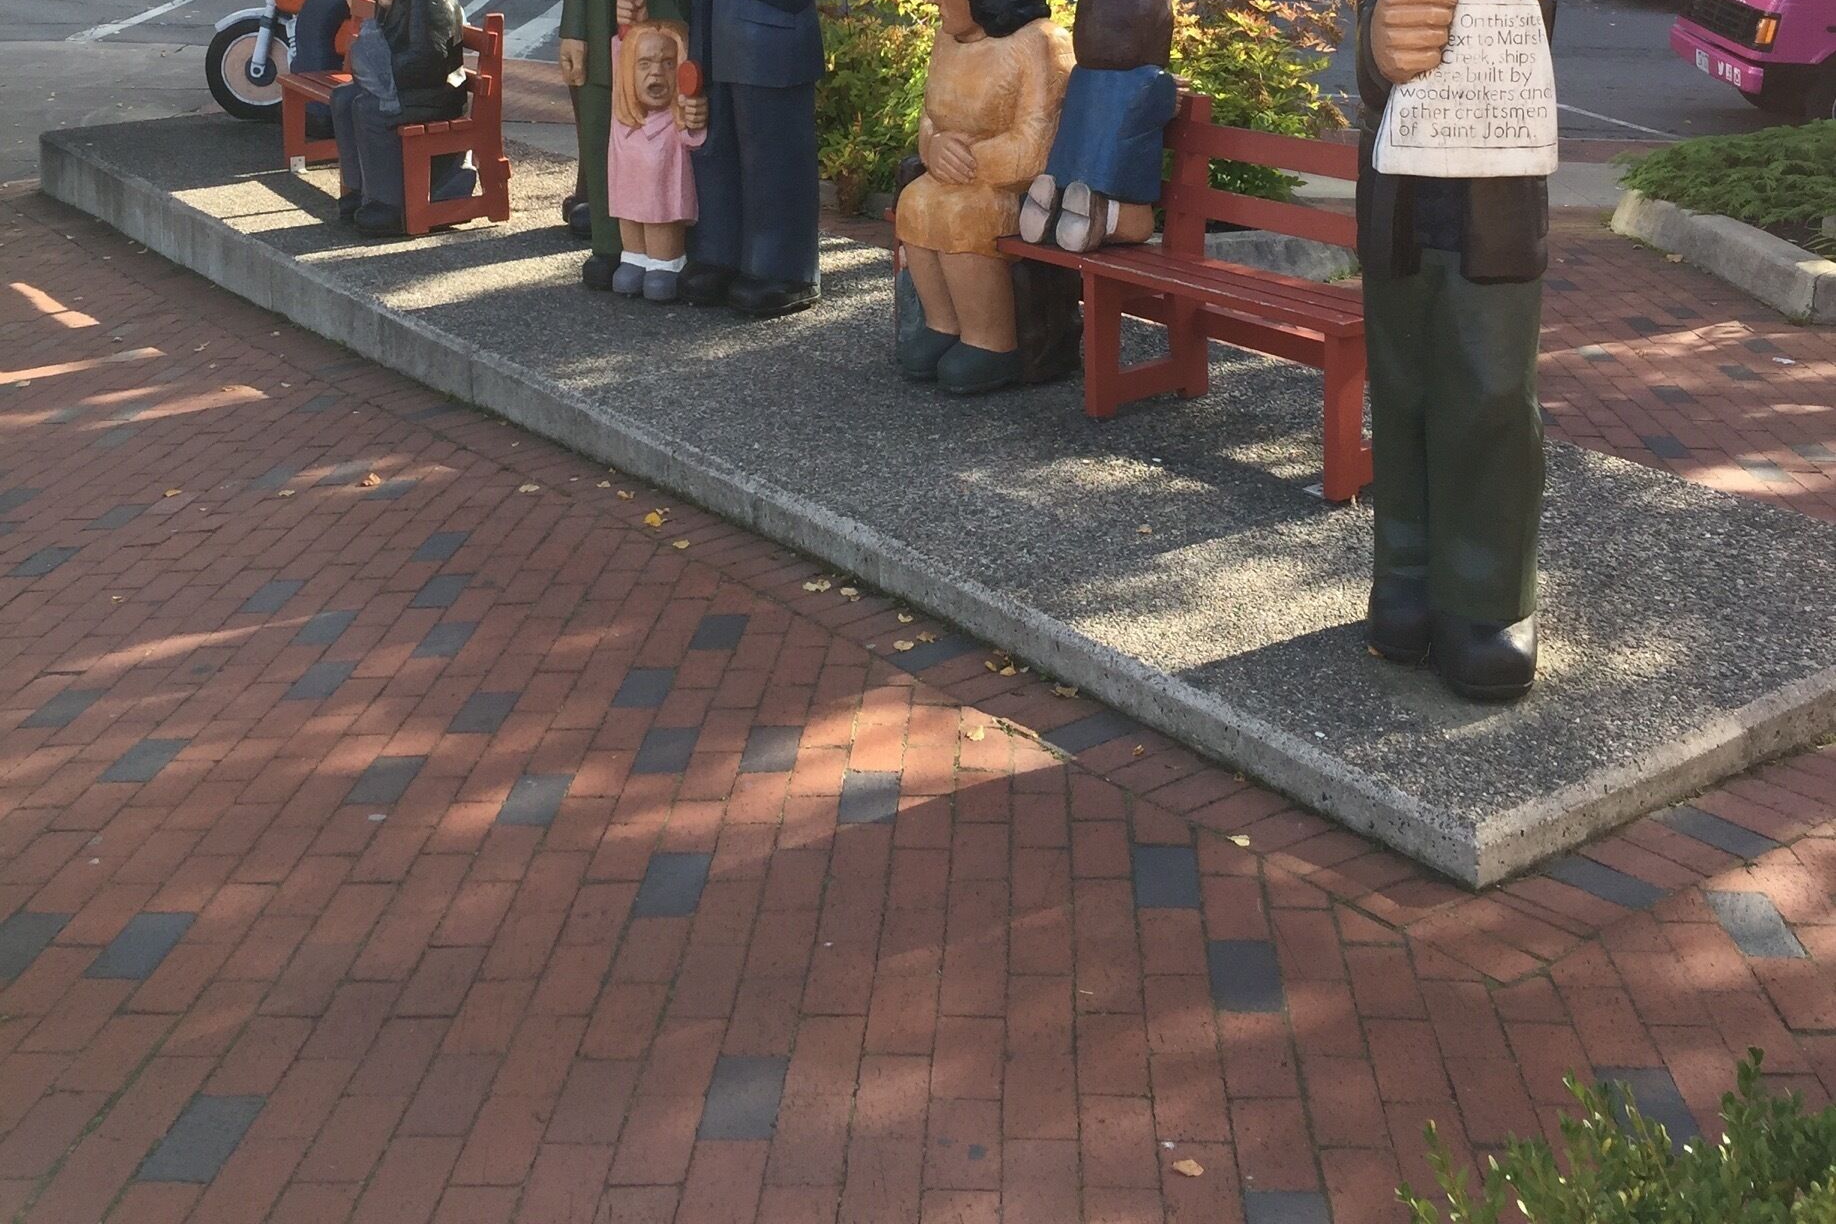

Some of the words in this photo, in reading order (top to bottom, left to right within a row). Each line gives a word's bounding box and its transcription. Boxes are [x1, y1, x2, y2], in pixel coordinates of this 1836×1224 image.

[1460, 14, 1485, 28] On
[1488, 13, 1514, 27] this
[1519, 13, 1542, 27] site
[1447, 34, 1473, 47] ext
[1478, 33, 1495, 47] to
[1498, 29, 1546, 46] Marsh
[1500, 49, 1536, 67] ships
[1466, 67, 1503, 84] built
[1510, 67, 1533, 87] by
[1400, 85, 1515, 102] woodworkers
[1519, 80, 1553, 101] and
[1399, 103, 1451, 120] other
[1455, 103, 1548, 120] craftsmen
[1398, 122, 1418, 137] of
[1430, 121, 1476, 138] Saint
[1483, 122, 1537, 139] John.
